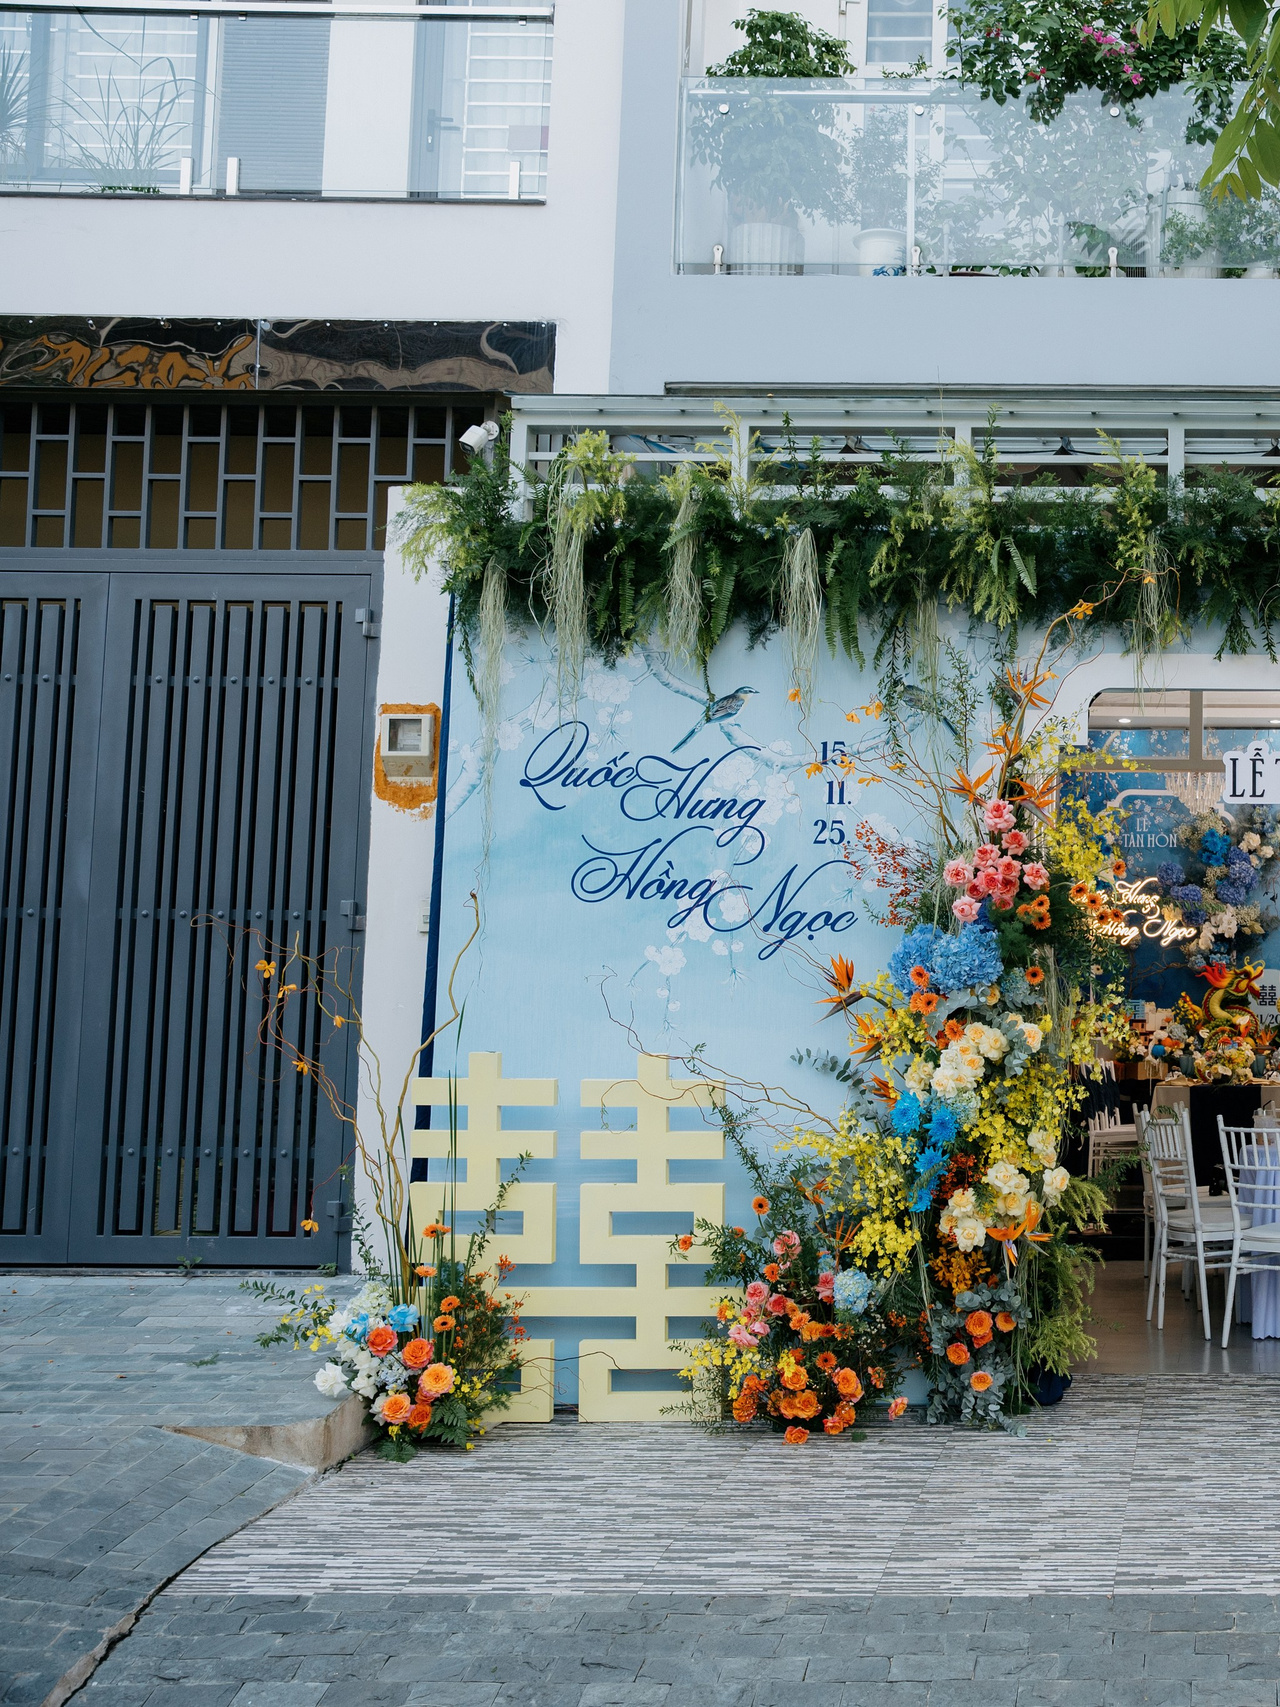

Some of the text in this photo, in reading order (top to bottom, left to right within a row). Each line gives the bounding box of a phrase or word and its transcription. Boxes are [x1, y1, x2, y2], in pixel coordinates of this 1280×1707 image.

[1229, 748, 1266, 798] LỄ
[519, 720, 766, 866] Quốc Hưng
[826, 780, 852, 805] 11.
[812, 819, 851, 845] 25.
[1122, 832, 1145, 848] TÂN
[571, 826, 859, 961] Hồng Ngọc
